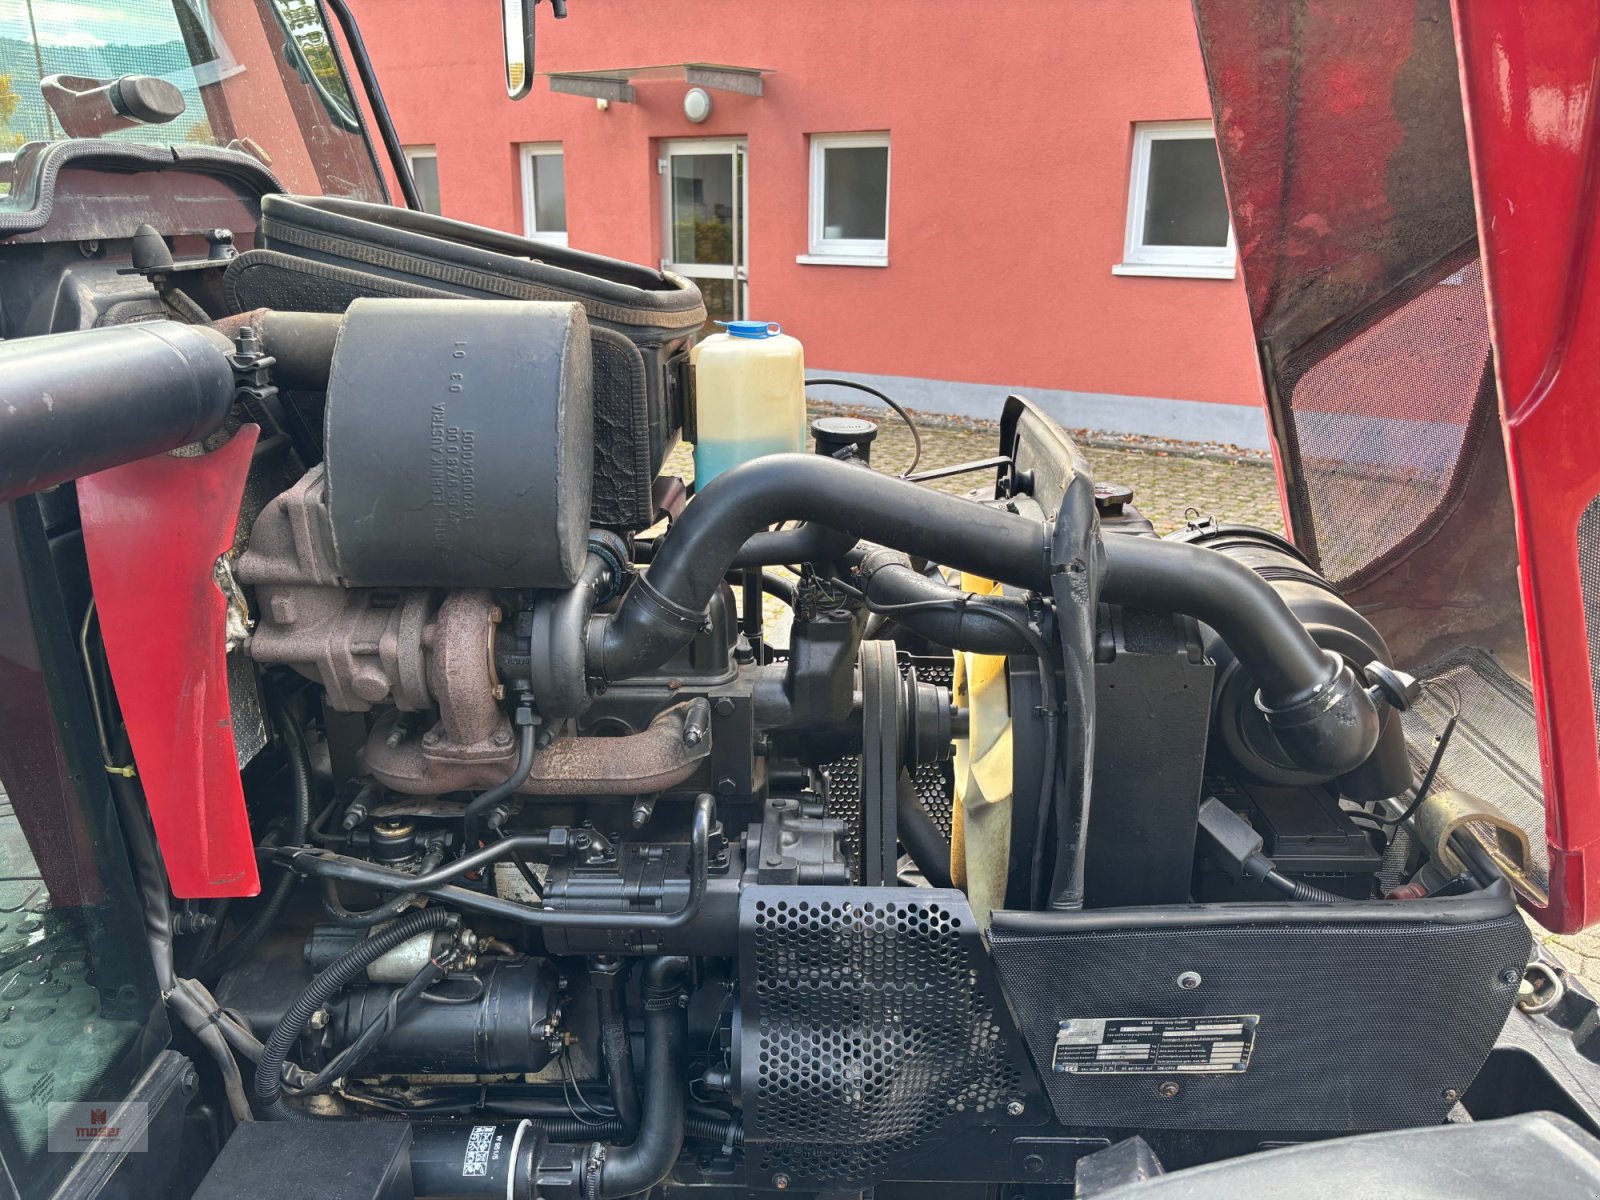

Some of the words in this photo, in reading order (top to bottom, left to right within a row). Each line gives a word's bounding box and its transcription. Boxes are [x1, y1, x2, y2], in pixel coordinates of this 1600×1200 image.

[452, 341, 468, 358] 01
[449, 372, 464, 392] 03
[430, 402, 445, 454] AUSTRIA
